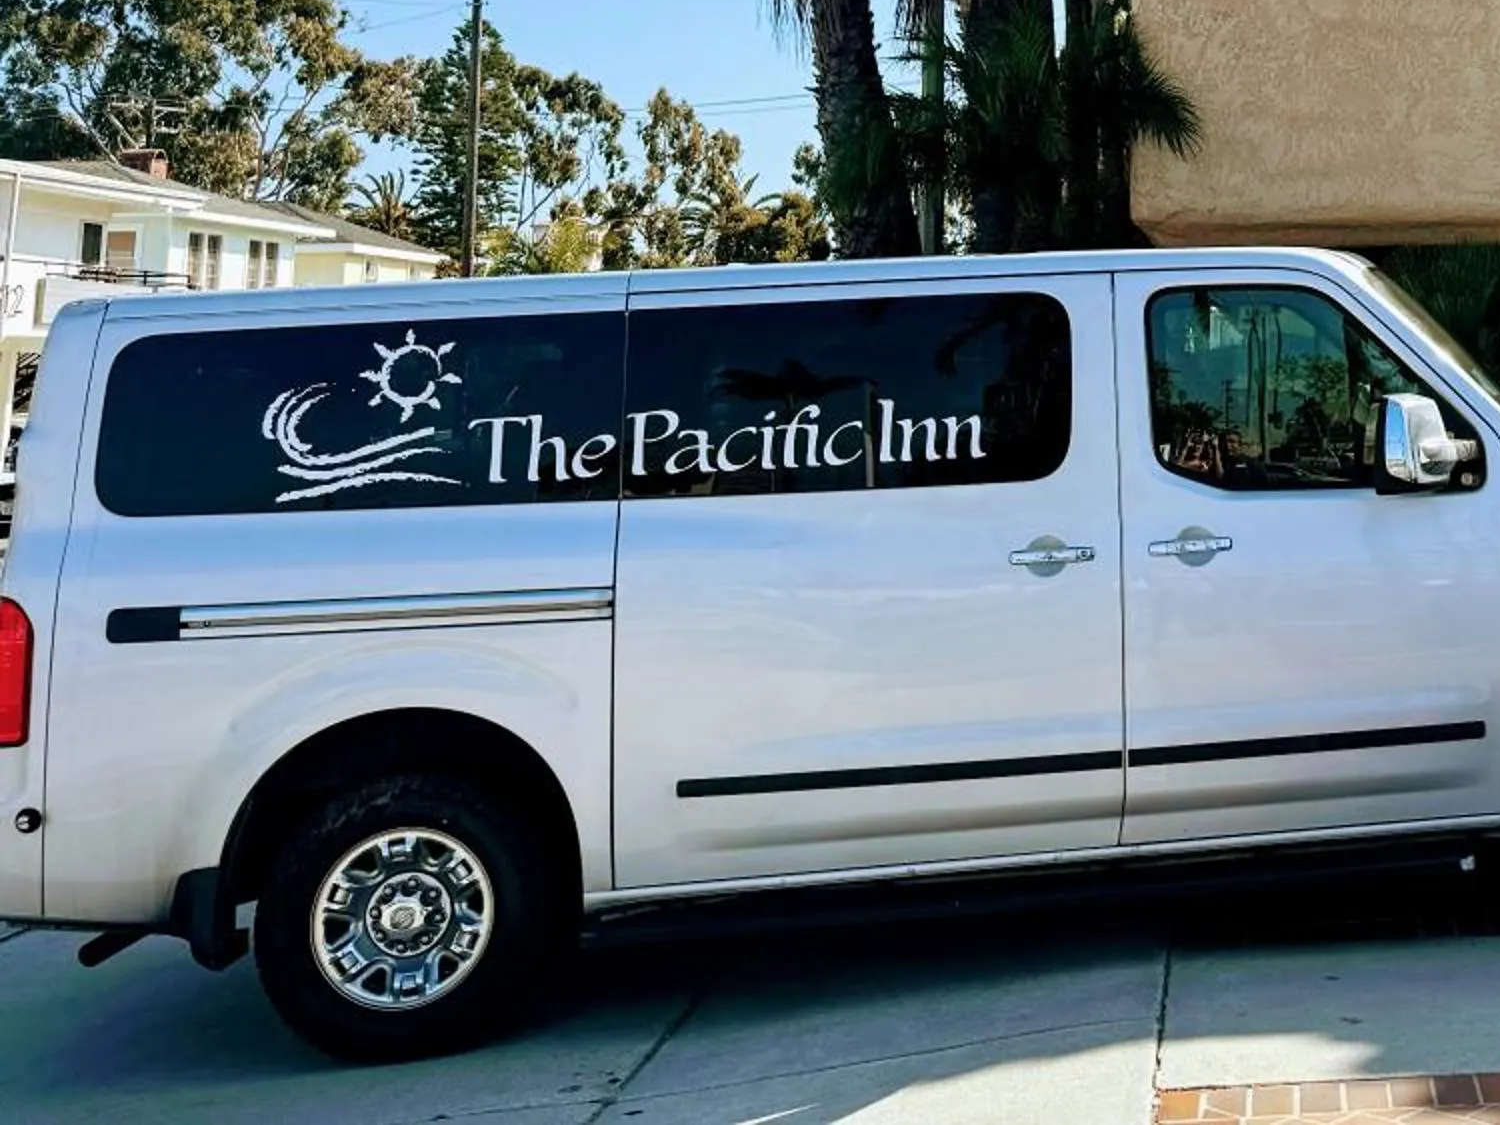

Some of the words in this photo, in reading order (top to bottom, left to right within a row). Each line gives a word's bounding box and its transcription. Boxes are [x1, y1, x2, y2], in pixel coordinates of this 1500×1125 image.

[467, 414, 617, 484] The
[626, 404, 863, 476] Pacific
[877, 398, 987, 463] Inn
